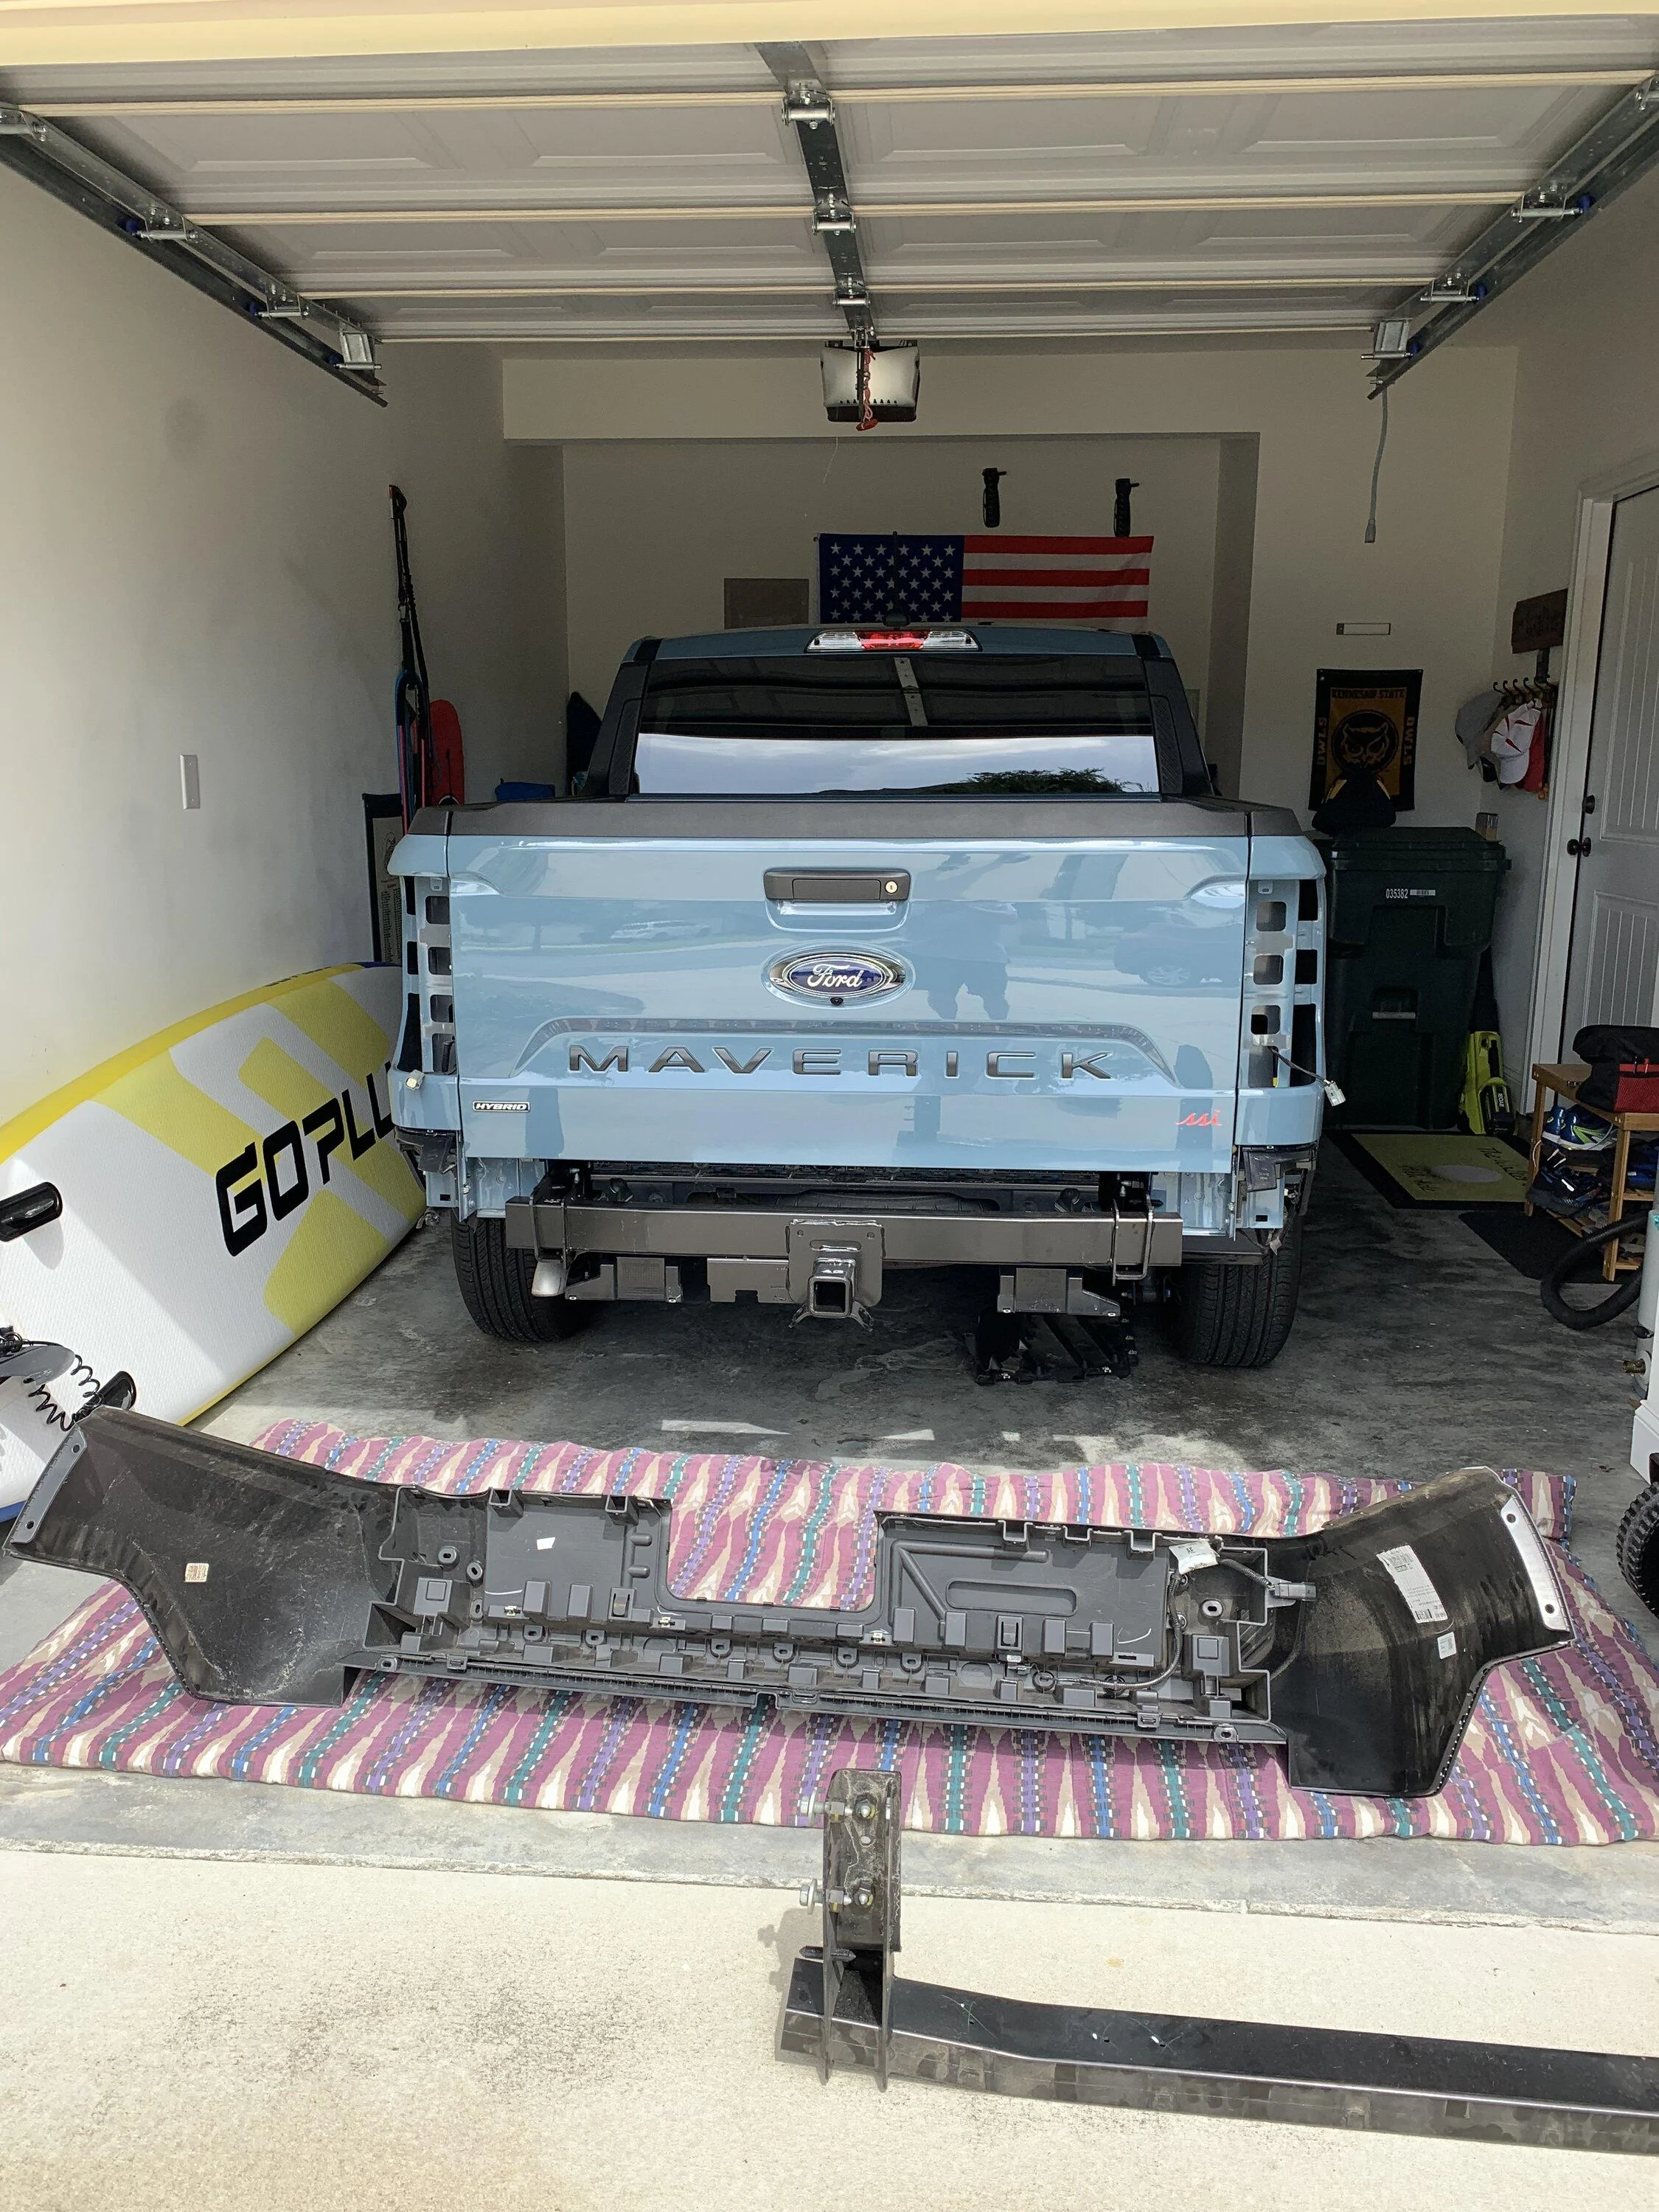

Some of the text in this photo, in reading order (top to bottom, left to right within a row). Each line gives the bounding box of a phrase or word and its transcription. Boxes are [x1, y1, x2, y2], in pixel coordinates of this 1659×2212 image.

[1385, 888, 1408, 899] 035382
[807, 963, 865, 988] Ford
[567, 1046, 1113, 1079] MAVERICK
[476, 1102, 527, 1110] HYBRID
